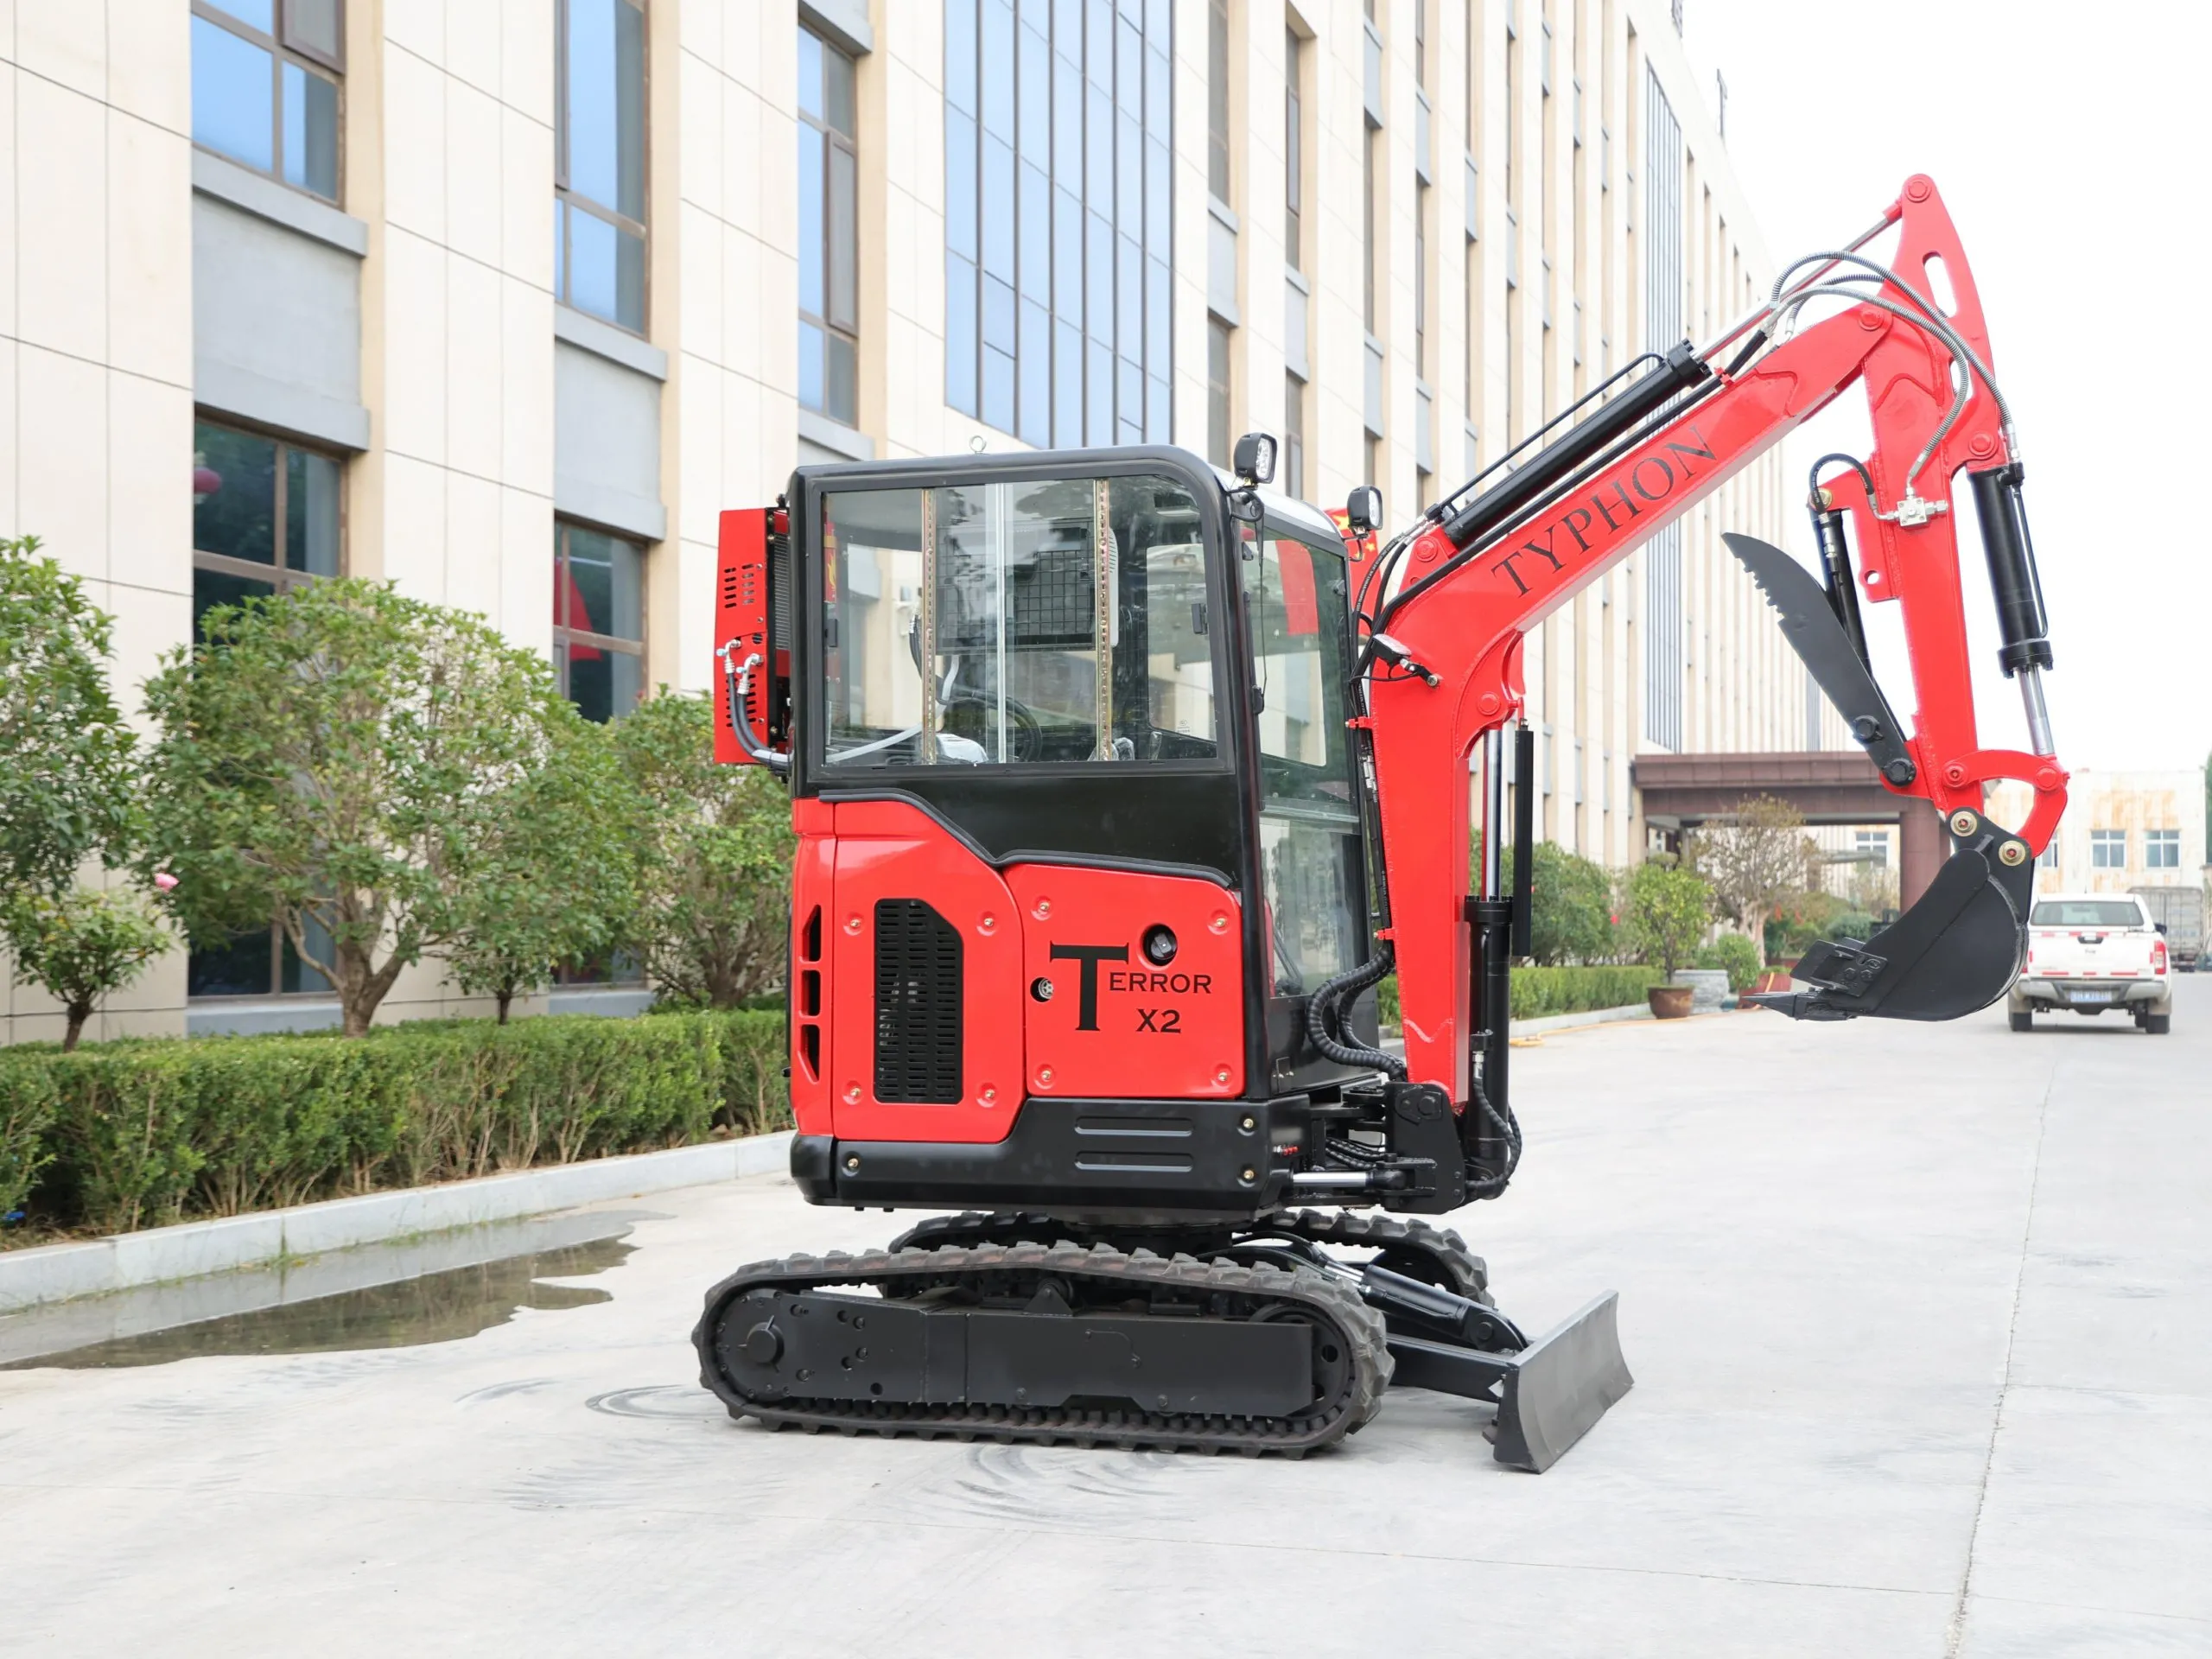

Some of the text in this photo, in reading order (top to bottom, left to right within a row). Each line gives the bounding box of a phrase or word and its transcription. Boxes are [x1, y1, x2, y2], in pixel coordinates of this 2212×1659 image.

[1491, 424, 1718, 598] TYPHON
[1049, 940, 1211, 1032] TERROR
[1135, 1008, 1181, 1033] X2
